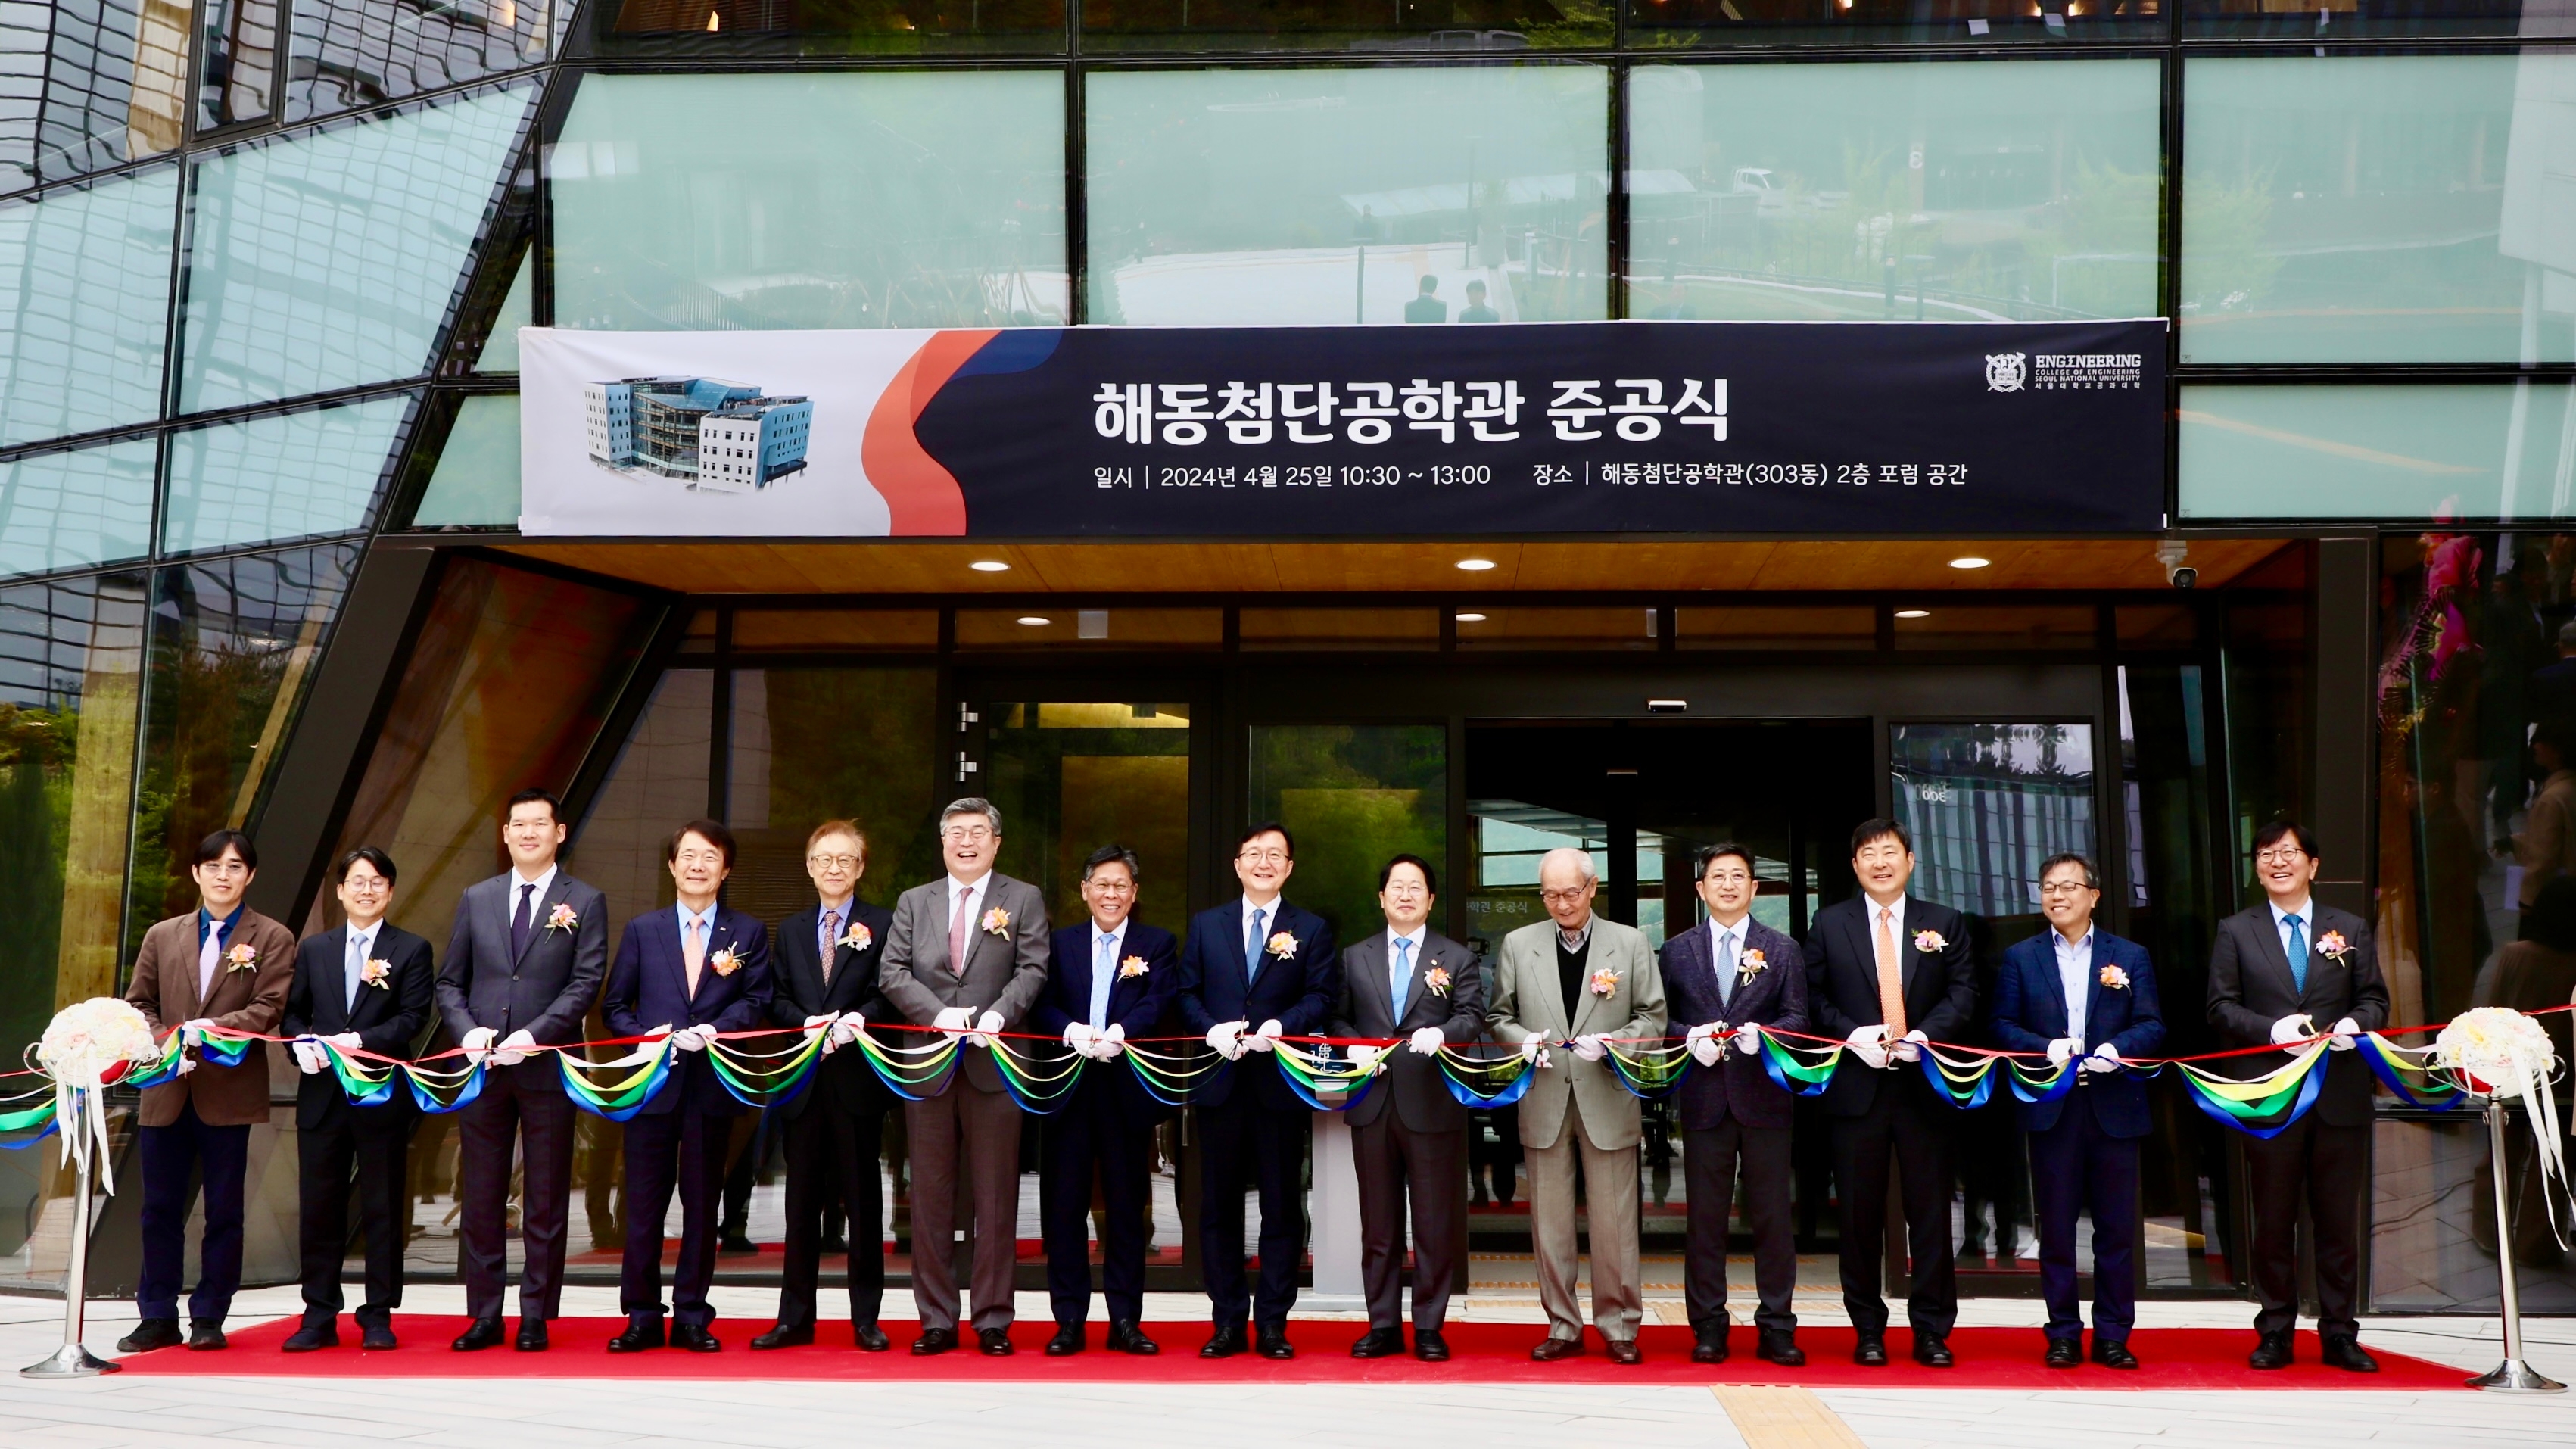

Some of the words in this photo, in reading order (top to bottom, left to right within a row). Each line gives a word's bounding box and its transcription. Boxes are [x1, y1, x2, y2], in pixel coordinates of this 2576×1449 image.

[2035, 354, 2141, 368] ENGINEERING
[1092, 379, 1525, 446] 해동첨단공학관
[1546, 378, 1729, 442] 준공식
[1094, 466, 1132, 488] 일시
[1160, 466, 1235, 488] 2024년
[1243, 466, 1278, 488] 4월
[1285, 466, 1332, 488] 25일
[1340, 466, 1400, 486] 10:30
[1430, 465, 1491, 485] 13:00
[1533, 463, 1574, 486] 장소
[1601, 463, 1828, 487] 해동첨단공학관(303동)
[1836, 463, 1871, 486] 2층
[1878, 463, 1918, 486] 포럼
[1927, 463, 1968, 486] 공간
